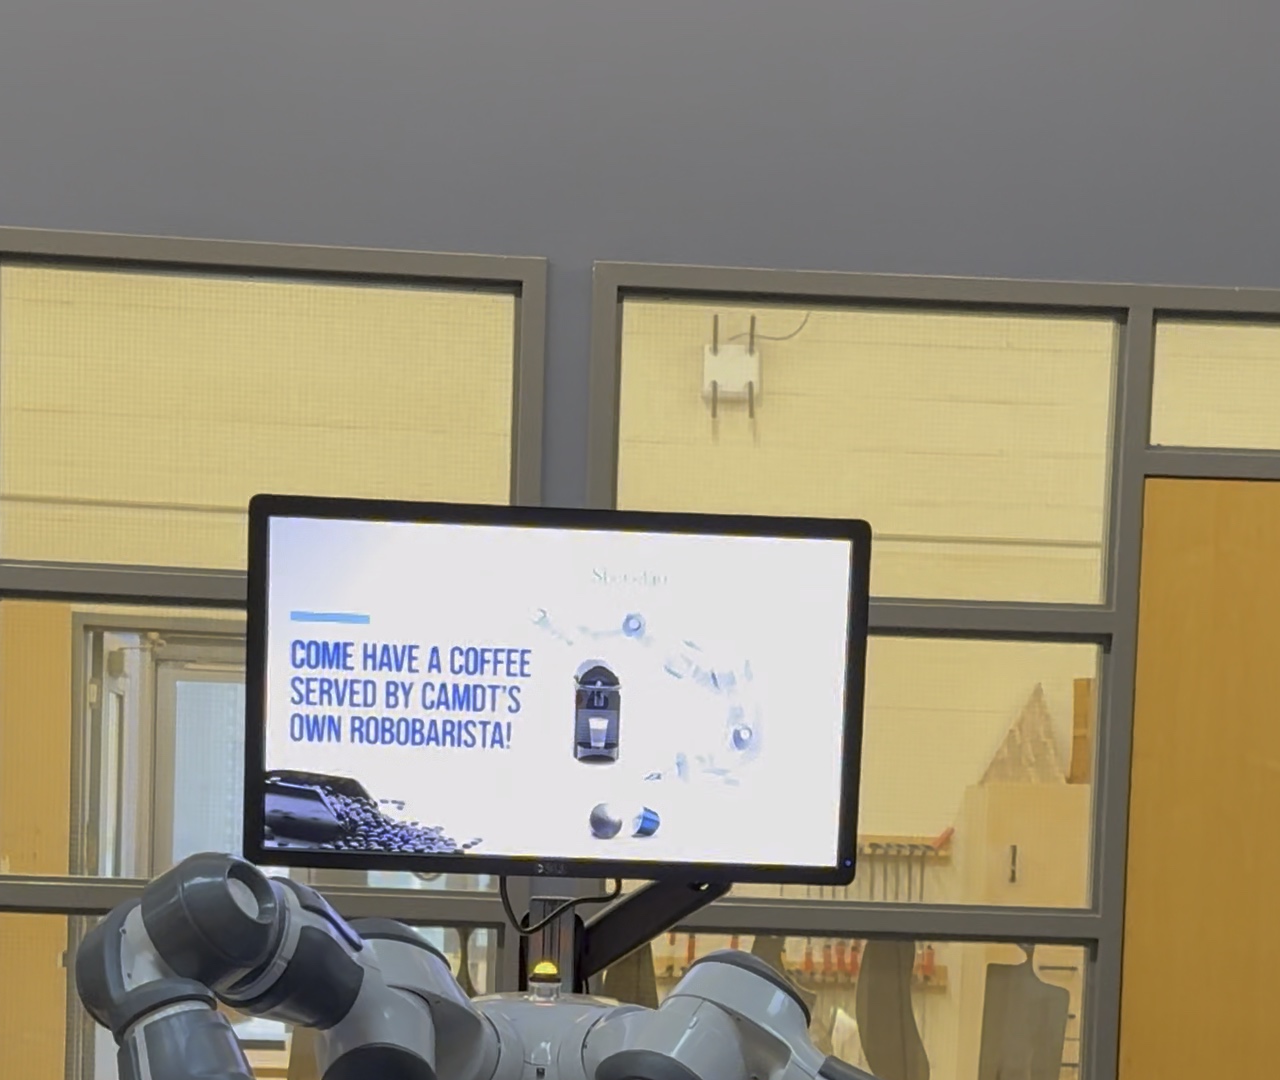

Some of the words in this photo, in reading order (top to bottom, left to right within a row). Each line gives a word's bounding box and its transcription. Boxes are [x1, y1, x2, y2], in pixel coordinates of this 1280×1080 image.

[291, 639, 355, 671] COME
[362, 643, 420, 673] HAVE
[427, 646, 442, 674] A
[449, 646, 532, 677] COFFEE
[290, 676, 377, 708] SERVED
[385, 681, 414, 709] BY
[290, 713, 342, 743] OWN
[350, 716, 513, 750] ROBOBARISTA!
